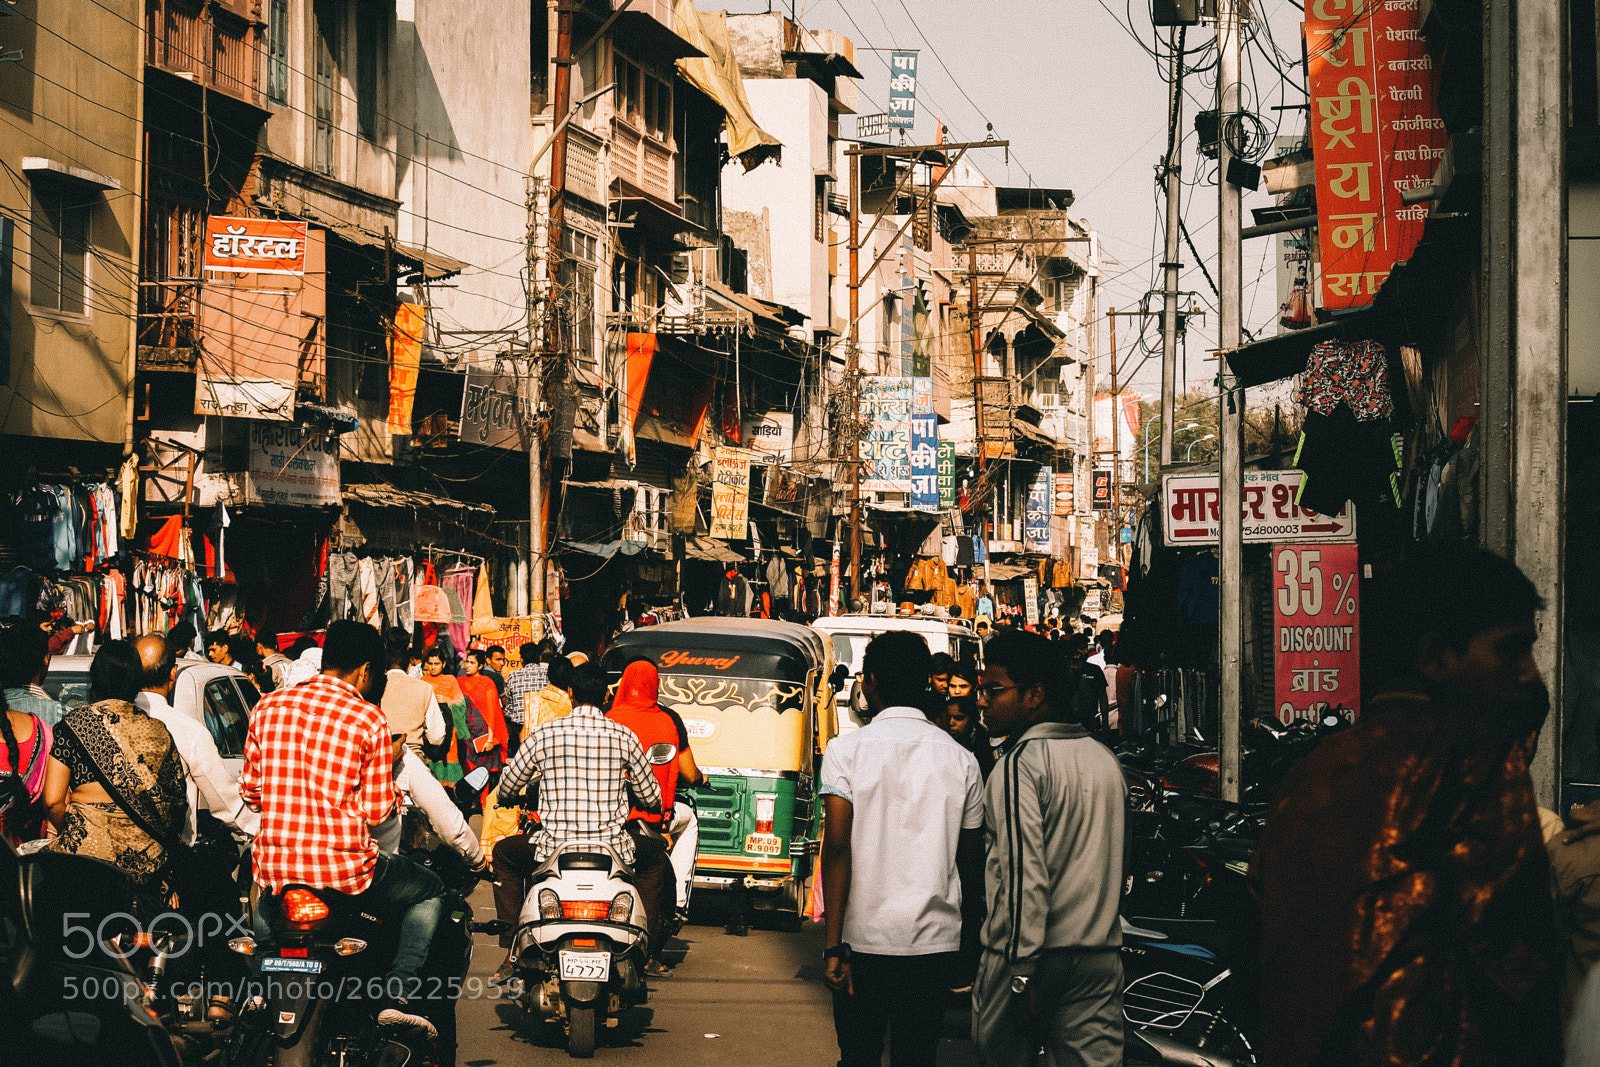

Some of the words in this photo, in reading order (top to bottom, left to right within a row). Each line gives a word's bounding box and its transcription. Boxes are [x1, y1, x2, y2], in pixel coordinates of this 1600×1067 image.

[1388, 54, 1432, 71] बनारसी
[211, 225, 300, 260] हॉस्टल
[1277, 548, 1324, 617] 35
[1332, 573, 1356, 616] %
[1280, 626, 1354, 653] DISCOUNT
[1290, 658, 1341, 693] ब्रांड
[565, 964, 605, 977] 4777
